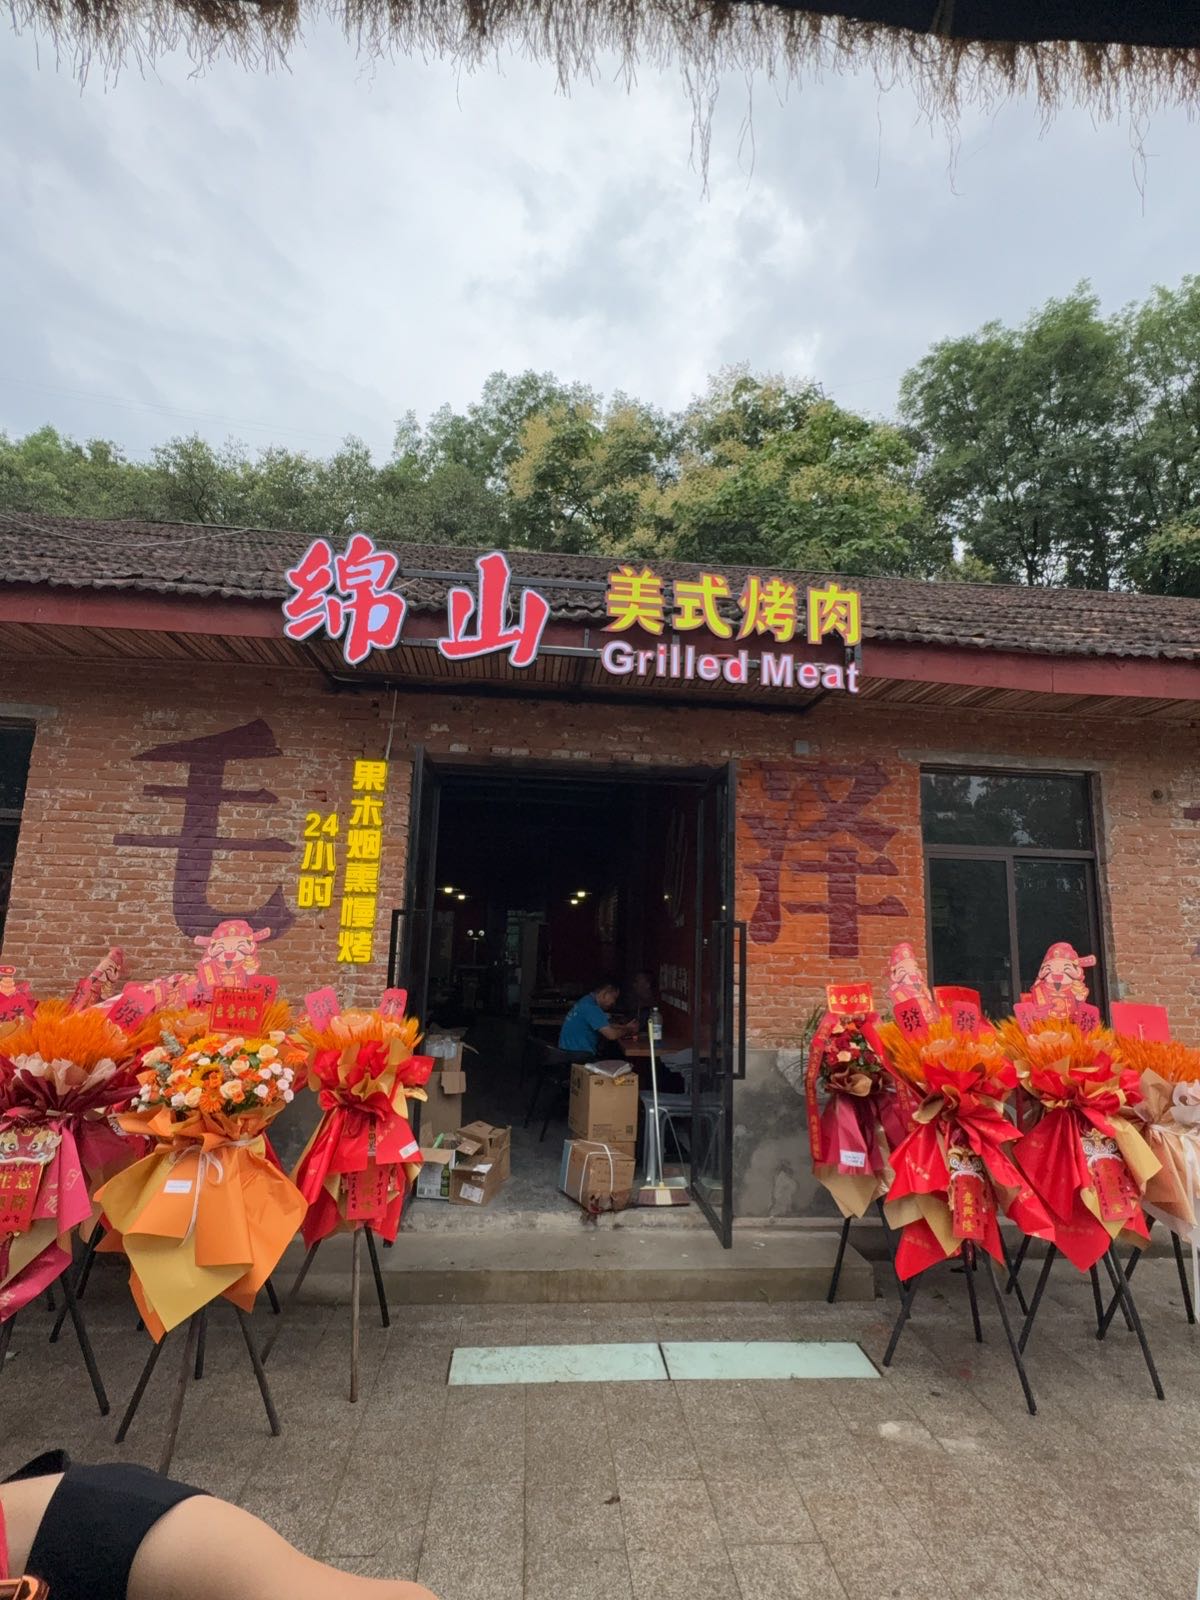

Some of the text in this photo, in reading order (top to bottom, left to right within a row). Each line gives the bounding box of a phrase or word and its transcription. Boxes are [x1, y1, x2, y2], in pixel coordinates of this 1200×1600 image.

[281, 533, 550, 668] 绵山
[600, 565, 862, 647] 美式烤肉
[601, 641, 860, 693] Grilled Meat
[298, 812, 339, 907] 24小时
[337, 760, 388, 963] 果木烟熏慢烤
